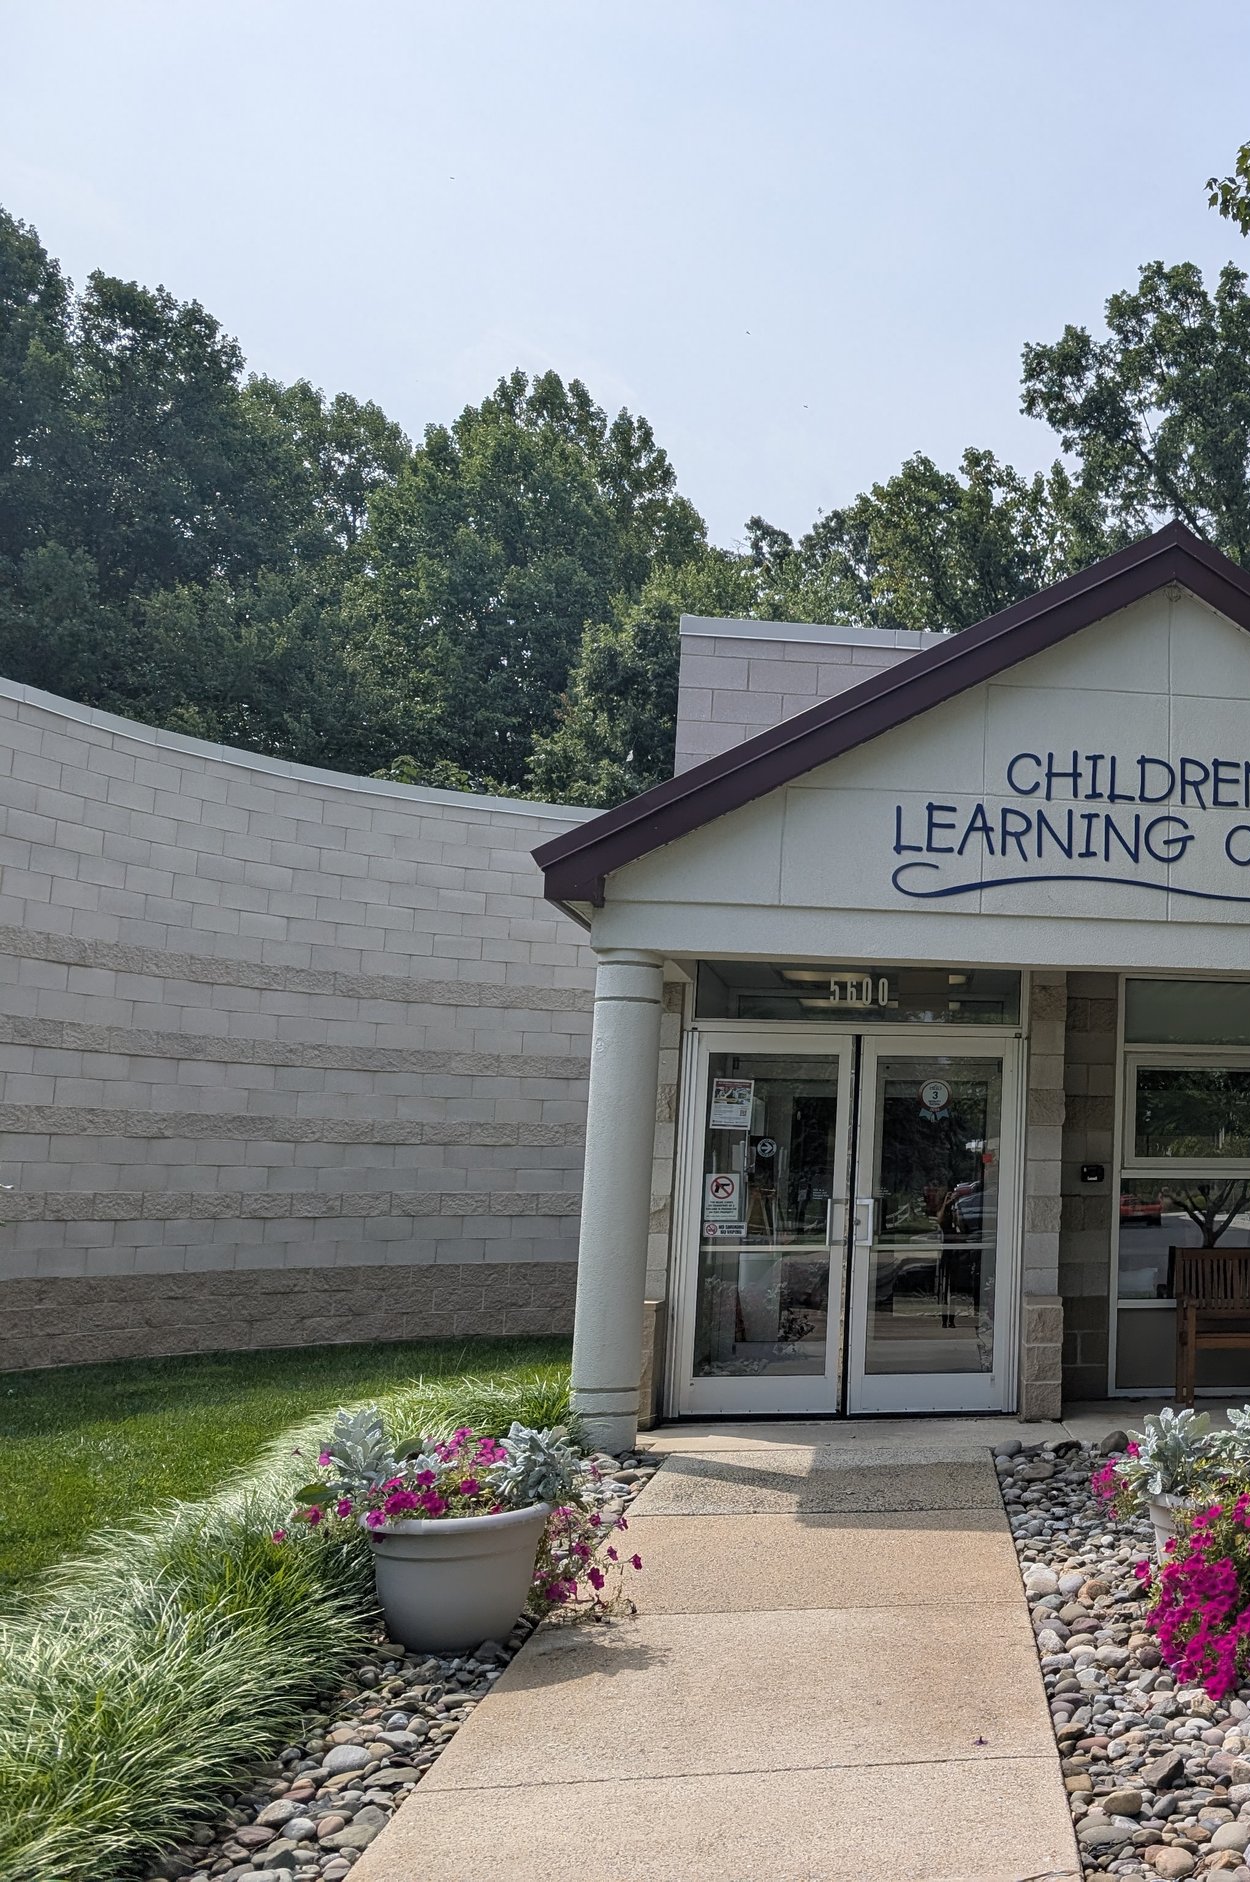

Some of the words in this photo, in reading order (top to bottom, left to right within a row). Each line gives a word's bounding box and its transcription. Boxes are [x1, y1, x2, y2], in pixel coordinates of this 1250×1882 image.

[893, 802, 1195, 867] LEARNING
[830, 977, 888, 1006] 5600
[932, 1091, 939, 1100] 3
